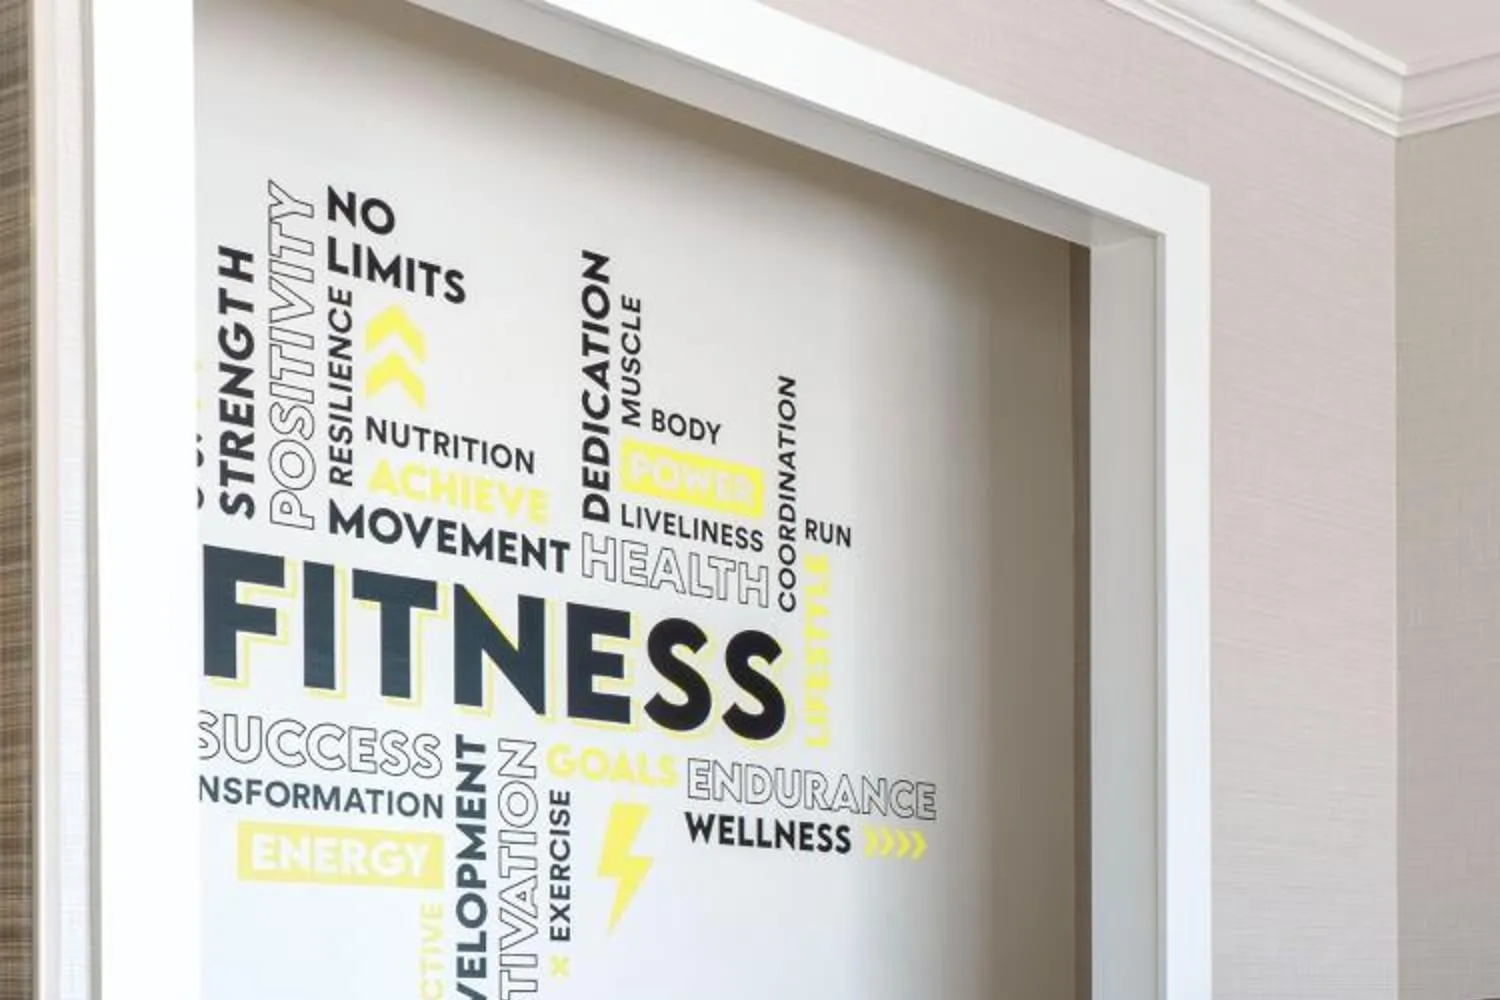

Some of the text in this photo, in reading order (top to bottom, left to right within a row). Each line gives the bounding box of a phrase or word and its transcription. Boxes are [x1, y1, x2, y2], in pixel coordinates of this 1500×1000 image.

[328, 185, 395, 235] NO
[328, 235, 466, 304] LIMITS
[218, 245, 255, 520] STRENGTH
[268, 179, 316, 531] POSITIVITY
[328, 285, 353, 487] RESILIENCE
[582, 250, 611, 523] DEDICATION
[621, 294, 642, 427] MUSCLE
[366, 416, 535, 474] NUTRITION
[651, 409, 721, 445] BODY
[368, 458, 550, 525] ACHIEVE
[778, 375, 796, 612] COORDINATION
[329, 499, 571, 574] MOVEMENT
[621, 503, 764, 552] LIVELINESS
[804, 518, 852, 548] RUN
[581, 532, 769, 608] HEALTH
[203, 544, 787, 741] FITNESS
[198, 709, 442, 779] SUCCESS
[546, 743, 679, 787] GOALS
[687, 757, 938, 821] ENDURANCE
[252, 834, 431, 878] ENERGY
[549, 790, 571, 942] EXERCISE
[685, 811, 852, 854] WELLNESS
